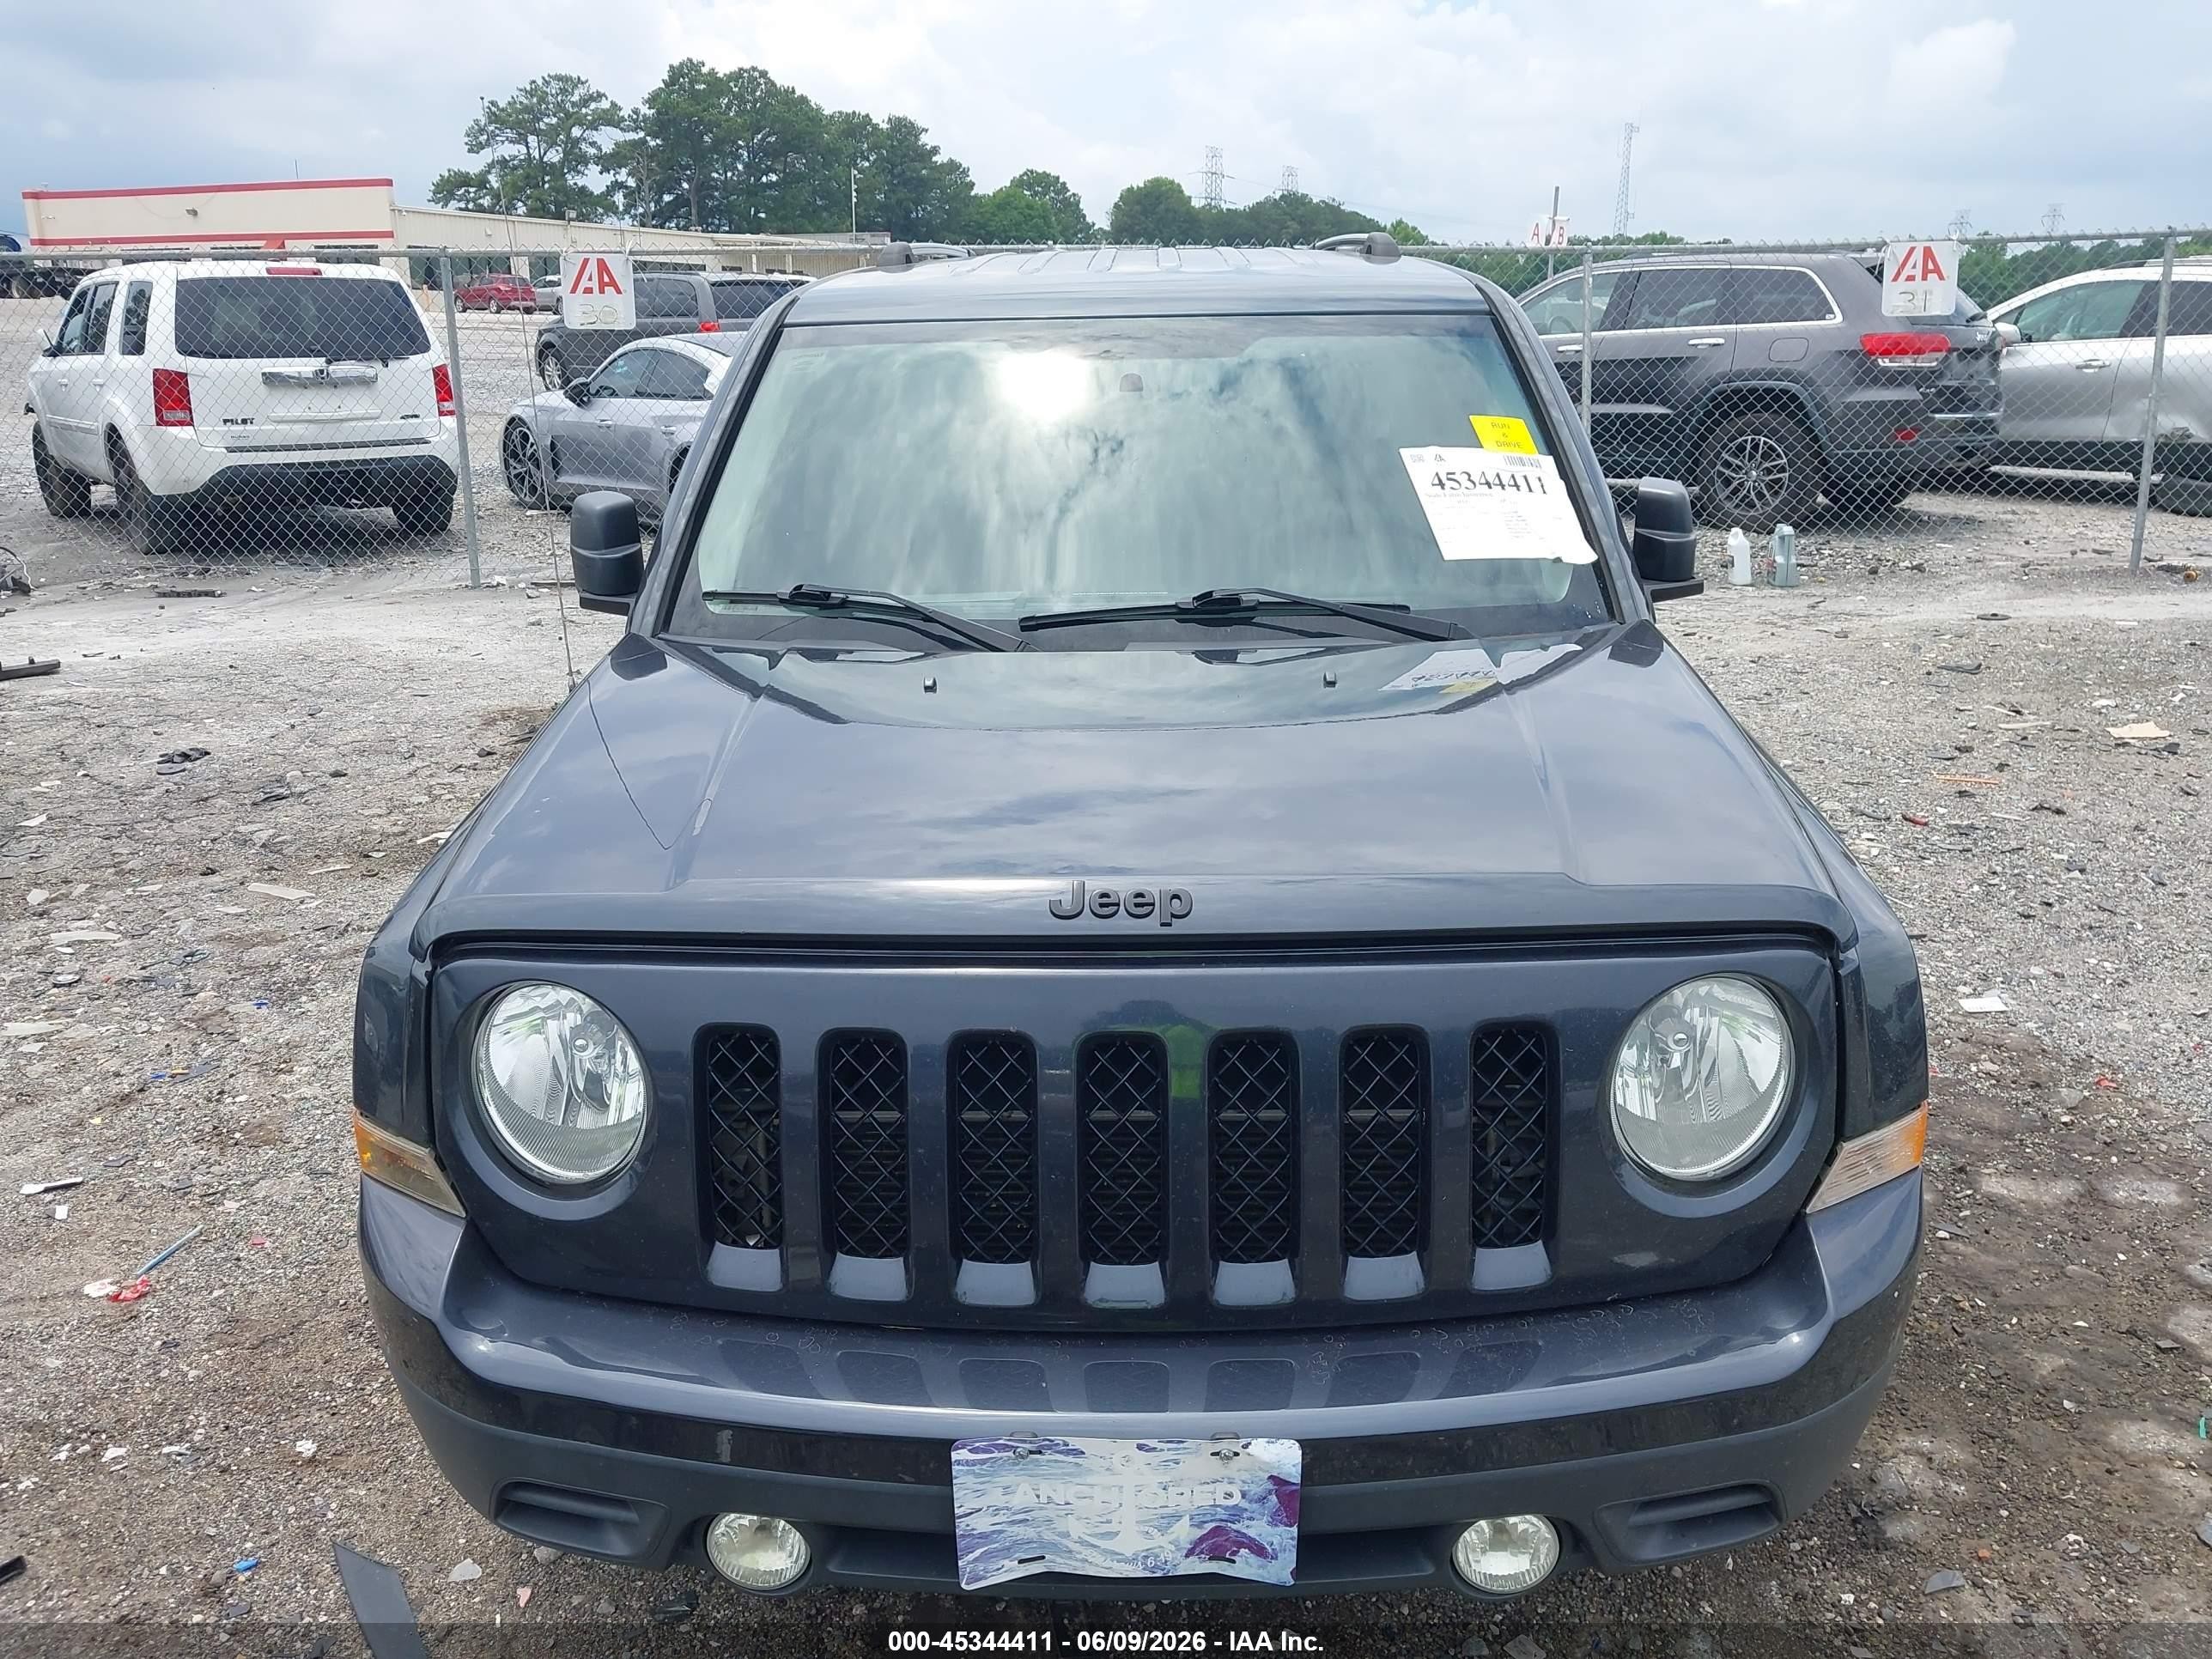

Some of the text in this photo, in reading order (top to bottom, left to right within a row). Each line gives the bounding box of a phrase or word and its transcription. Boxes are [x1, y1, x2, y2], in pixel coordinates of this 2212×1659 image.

[1898, 289, 1928, 313] 31
[222, 417, 255, 426] PILOT
[1496, 441, 1523, 449] DRIVE
[1431, 471, 1547, 495] 45344411
[1048, 879, 1194, 927] Jeep
